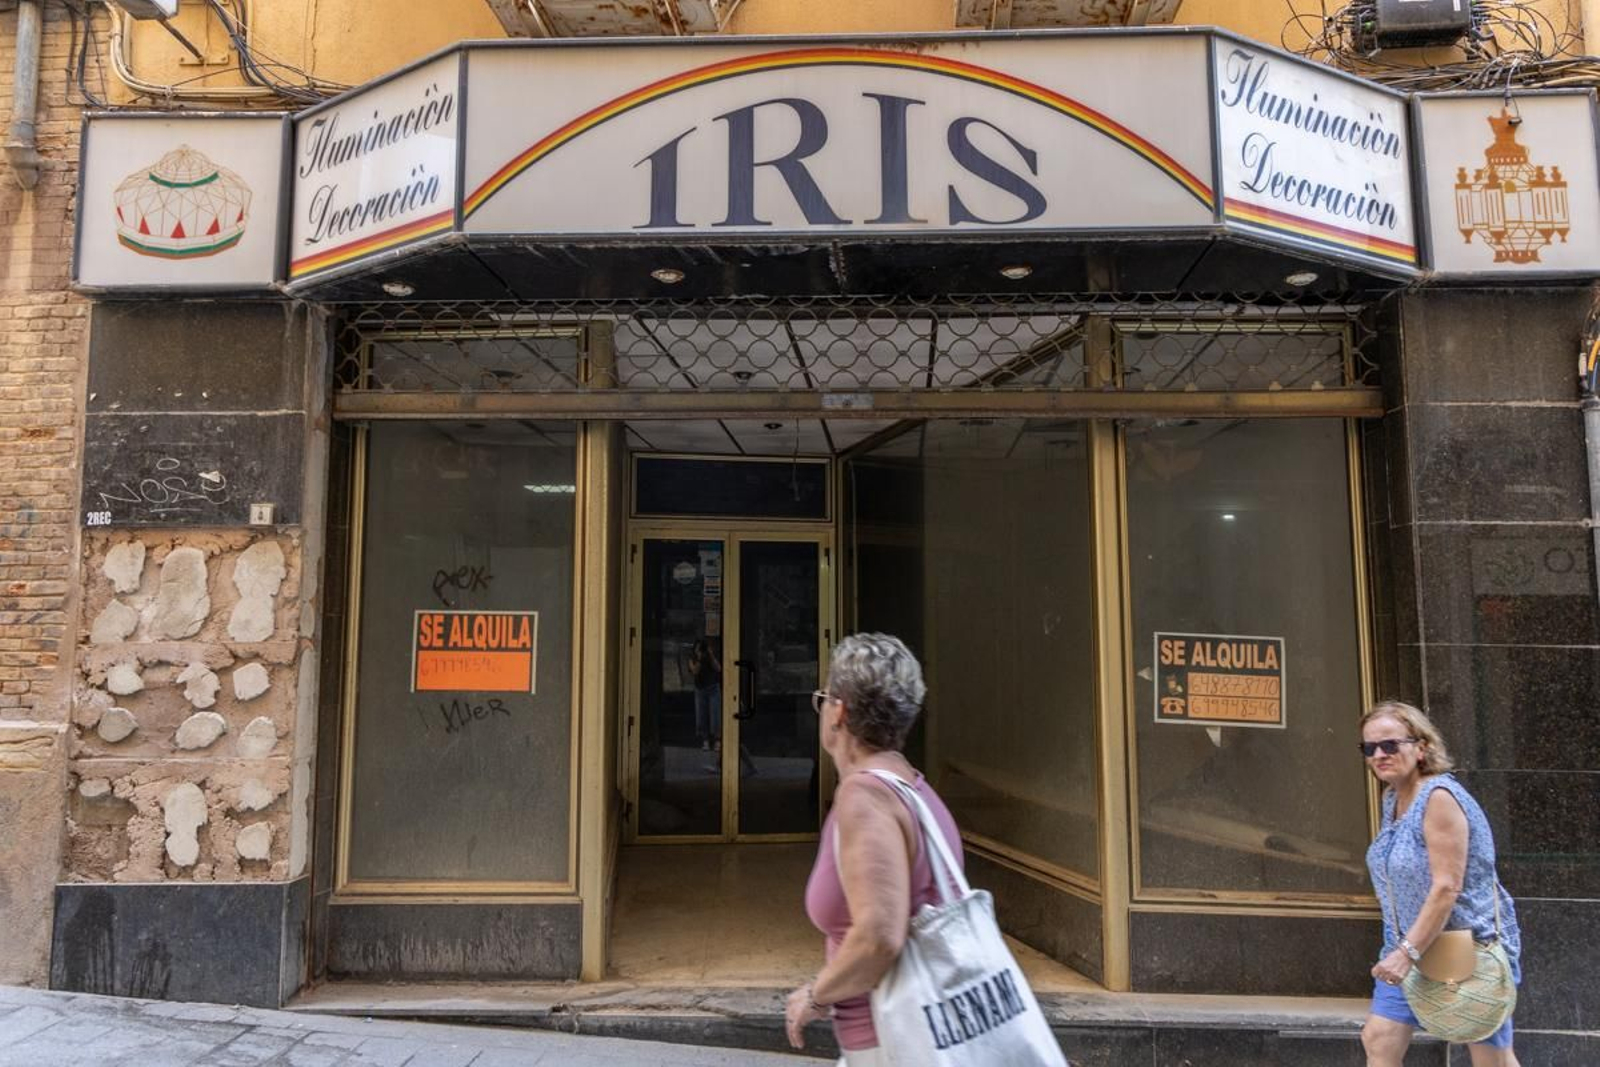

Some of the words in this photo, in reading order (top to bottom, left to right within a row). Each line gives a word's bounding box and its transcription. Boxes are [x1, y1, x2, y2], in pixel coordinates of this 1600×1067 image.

[633, 92, 1048, 228] IRIS
[419, 615, 444, 648] SE
[449, 615, 531, 650] ALQUILA
[1160, 639, 1186, 666] SE
[1191, 641, 1279, 670] ALQUILA
